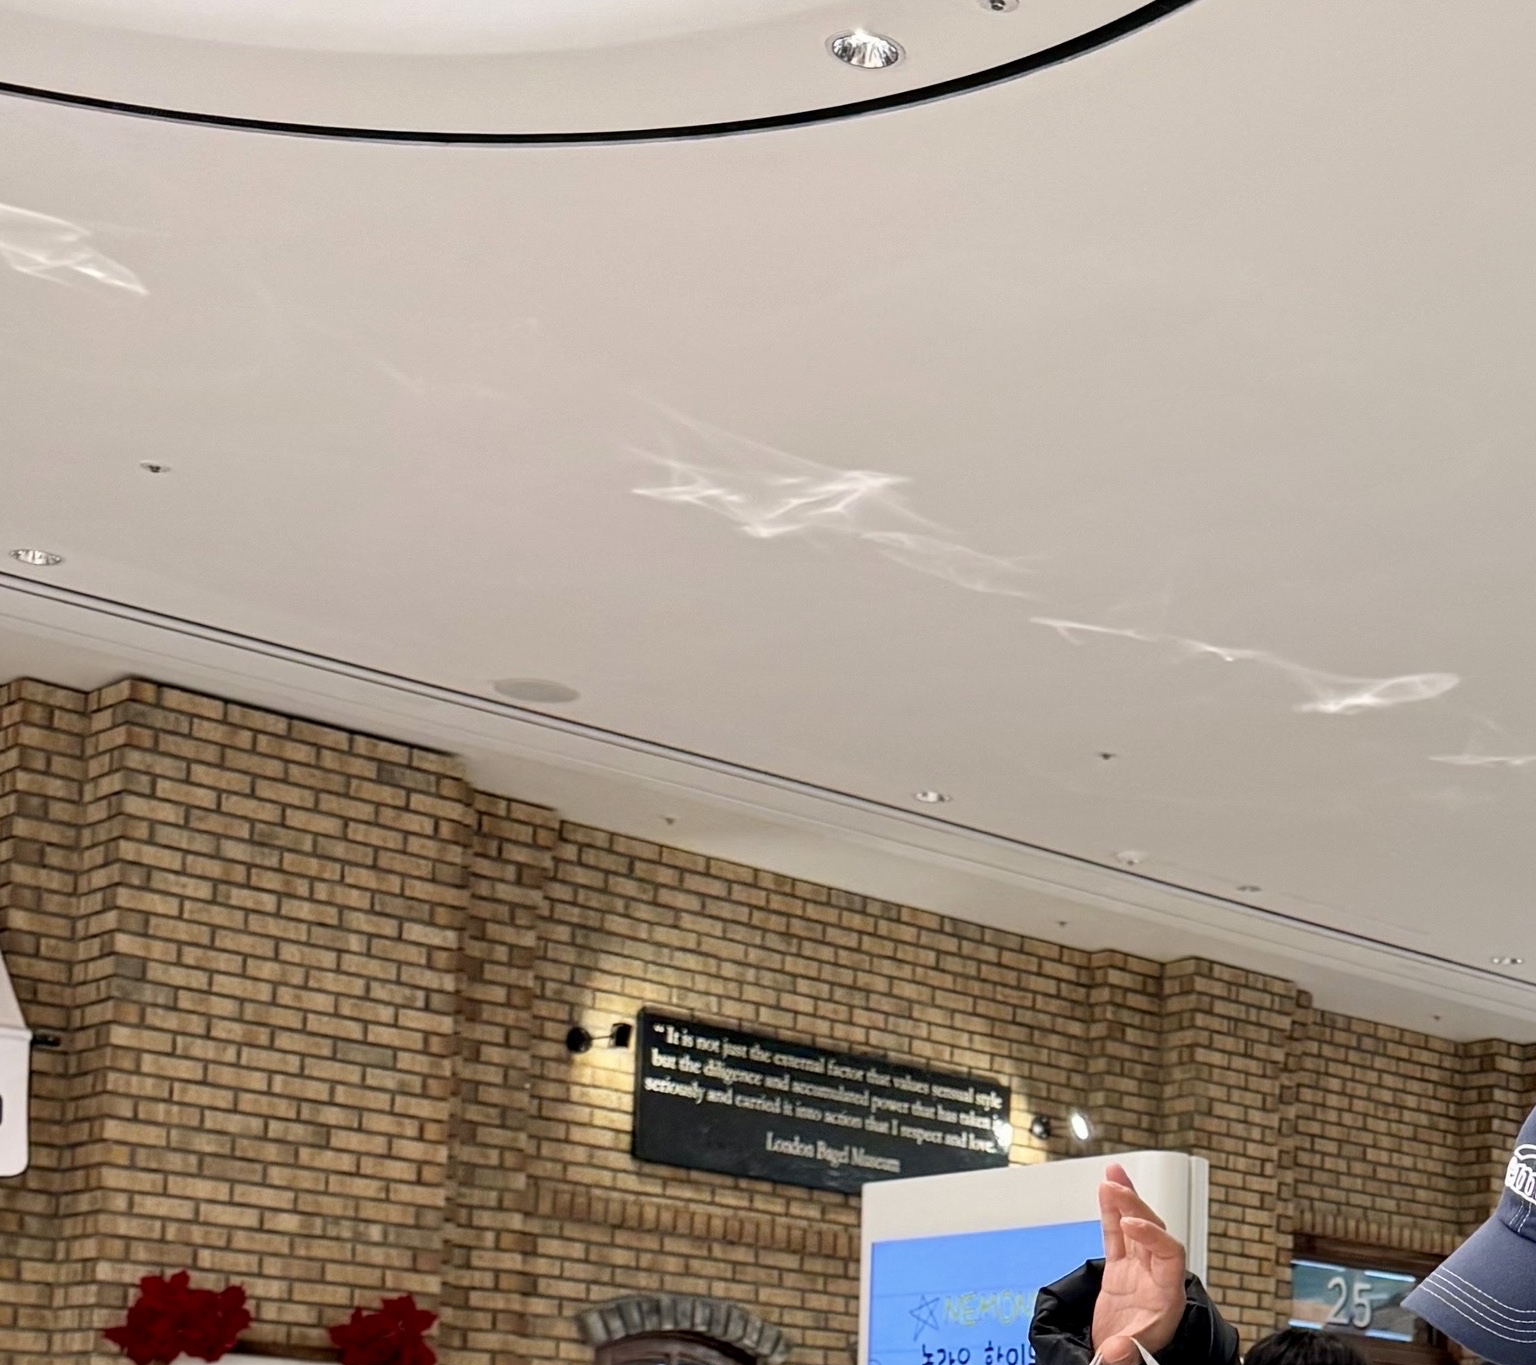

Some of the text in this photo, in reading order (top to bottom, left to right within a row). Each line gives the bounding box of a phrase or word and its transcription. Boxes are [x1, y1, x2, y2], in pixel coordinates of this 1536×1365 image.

[651, 1048, 677, 1070] but
[678, 1054, 702, 1074] the
[702, 1058, 763, 1086] diligence
[764, 1074, 790, 1092] and
[871, 1096, 910, 1114] power
[911, 1100, 936, 1120] that
[937, 1104, 958, 1123] has
[681, 1029, 694, 1048] is
[696, 1036, 721, 1053] not
[722, 1036, 748, 1059] just
[749, 1043, 772, 1063] the
[827, 1058, 864, 1082] factor
[866, 1067, 891, 1087] that
[893, 1074, 930, 1095] values
[975, 1091, 1003, 1111] style
[644, 1075, 706, 1104] seriously
[707, 1088, 733, 1105] and
[735, 1094, 781, 1114] carried
[782, 1100, 793, 1116] it
[795, 1101, 822, 1121] into
[823, 1110, 862, 1128] action
[865, 1115, 889, 1134] that
[892, 1119, 898, 1136] I
[900, 1125, 943, 1145] respect
[944, 1132, 967, 1146] and
[766, 1132, 900, 1173] London Bagel Museum
[1325, 1275, 1373, 1329] 25
